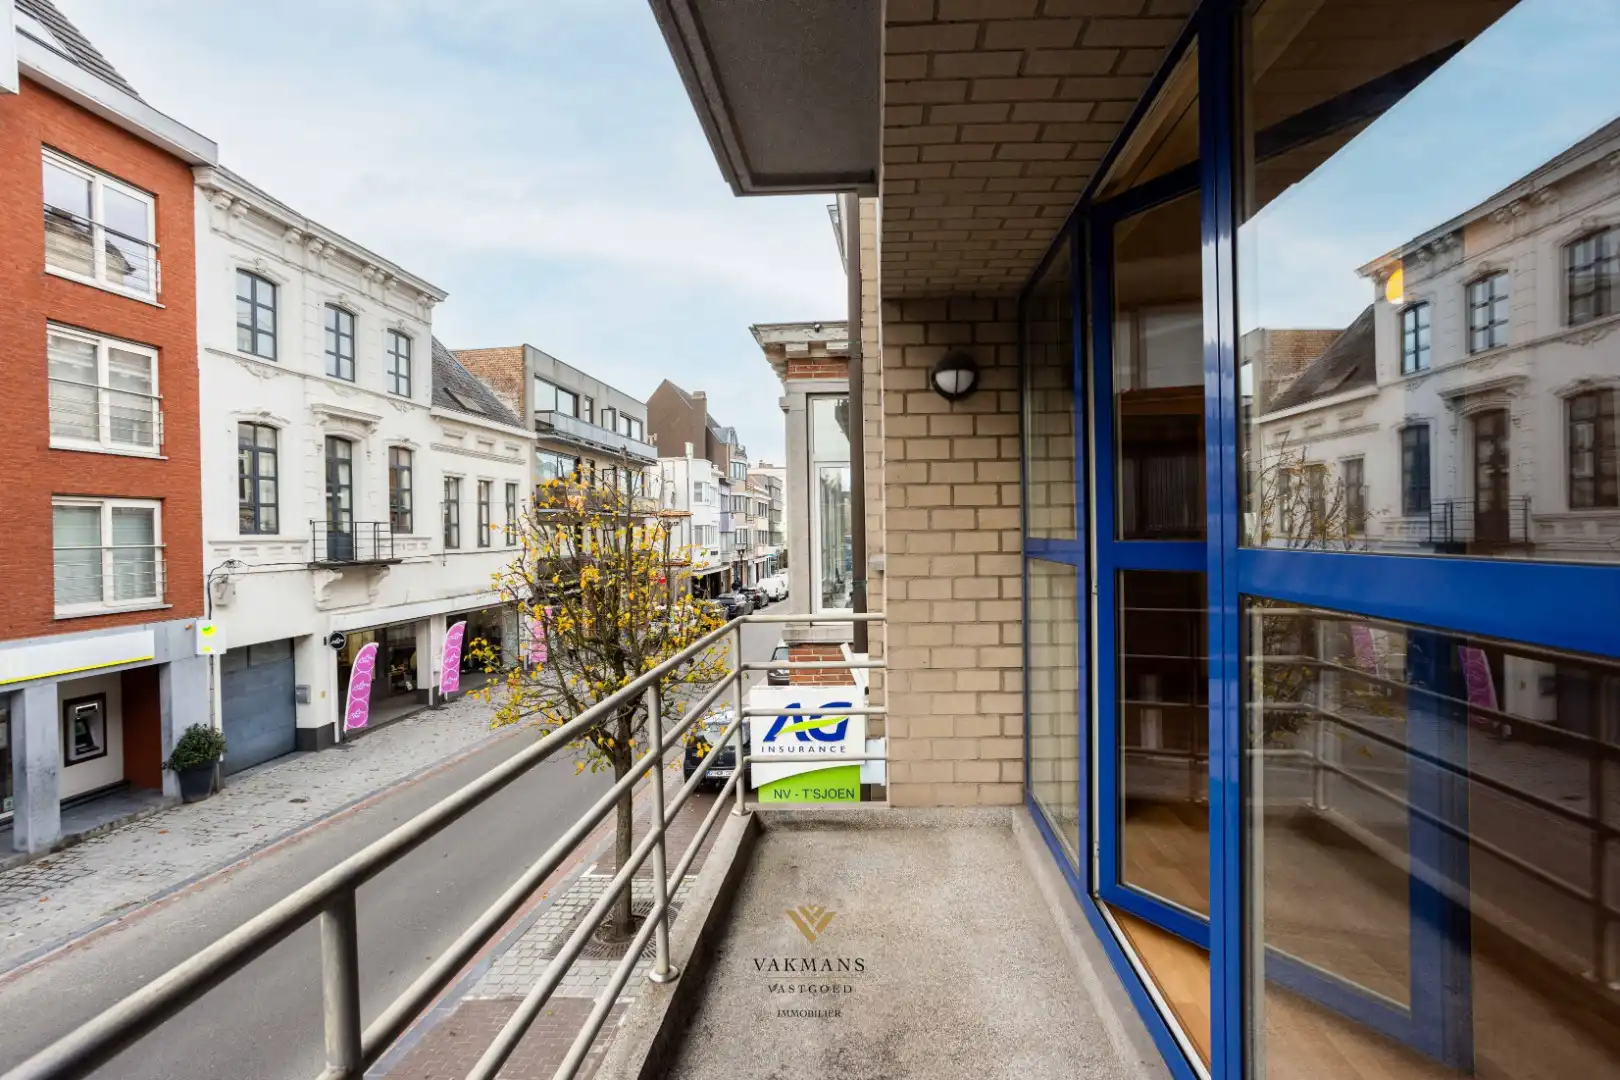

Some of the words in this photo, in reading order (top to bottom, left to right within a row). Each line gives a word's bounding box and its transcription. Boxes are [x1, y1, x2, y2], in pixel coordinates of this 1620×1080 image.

[763, 702, 852, 742] AG
[773, 788, 792, 799] NV
[803, 788, 855, 799] T'SJOEN
